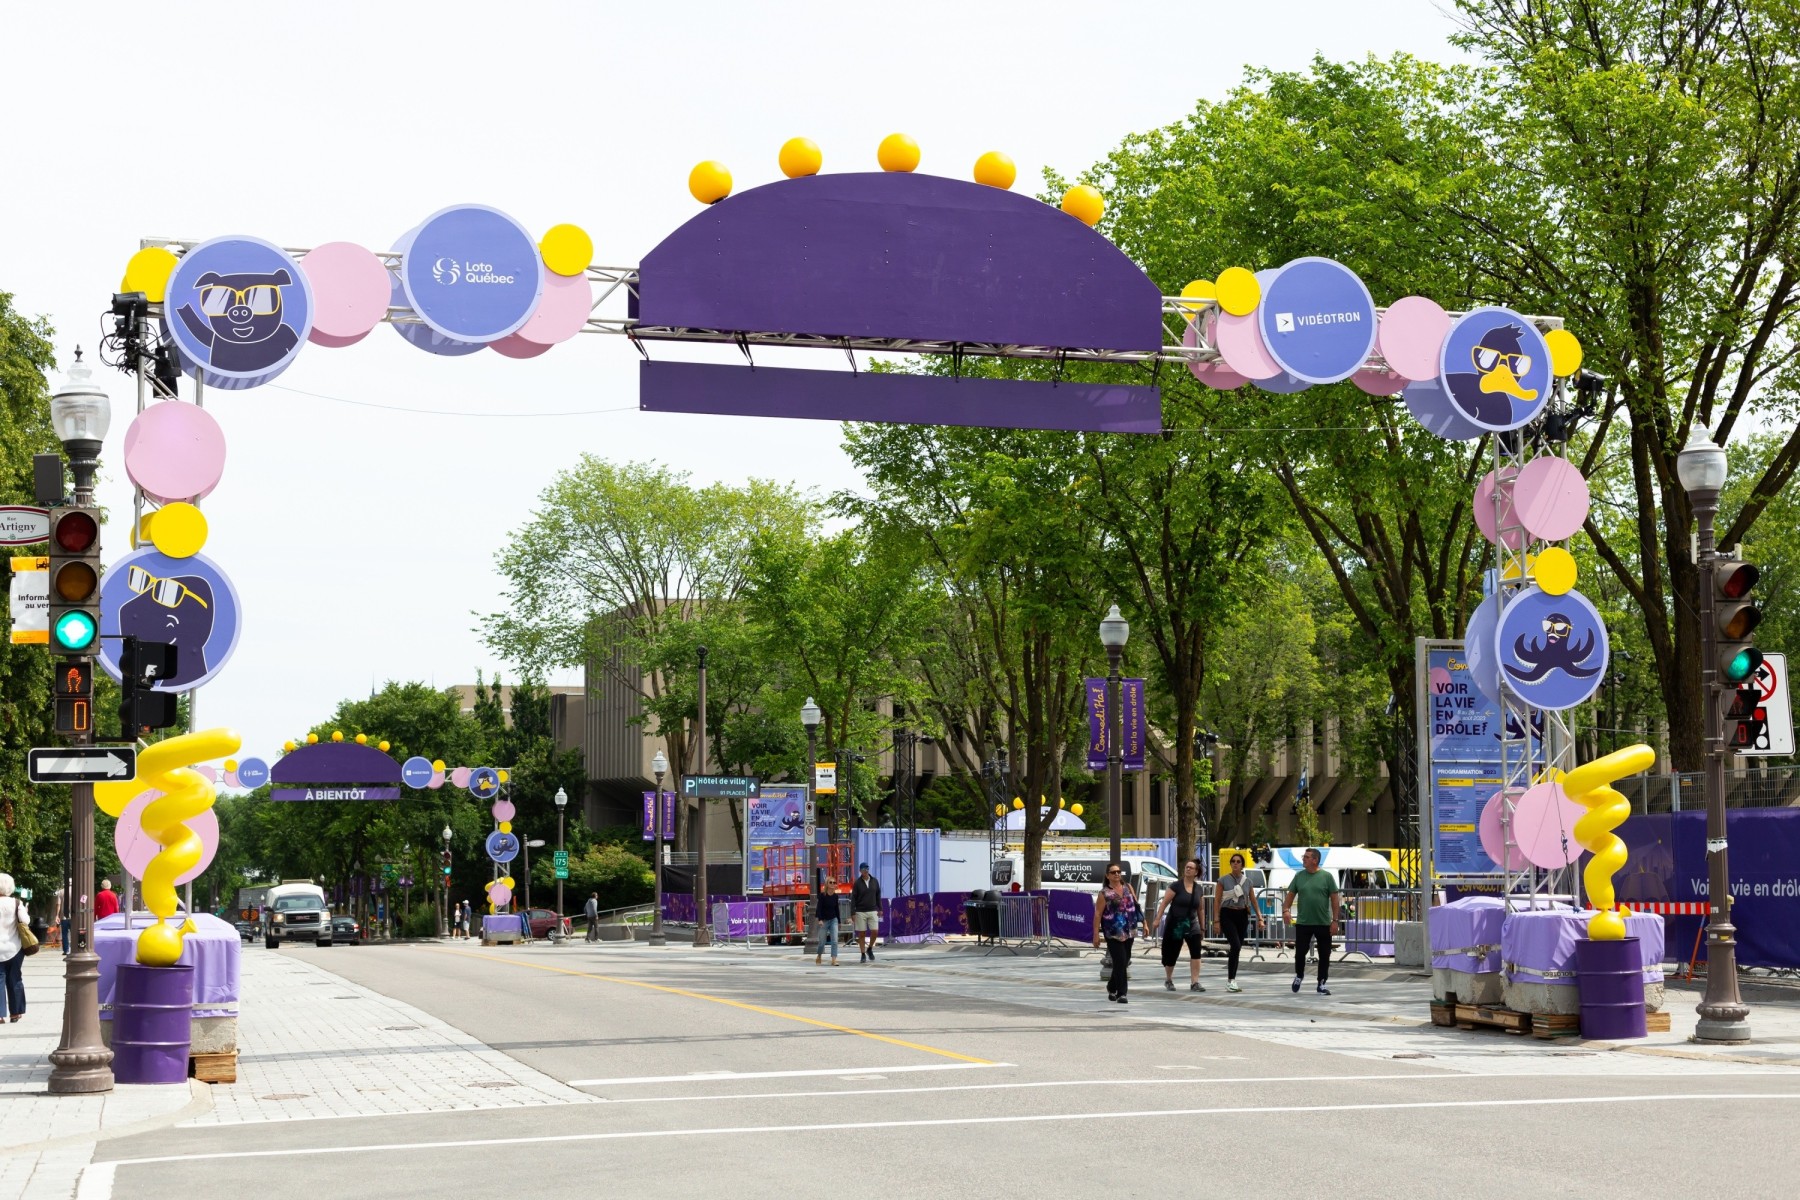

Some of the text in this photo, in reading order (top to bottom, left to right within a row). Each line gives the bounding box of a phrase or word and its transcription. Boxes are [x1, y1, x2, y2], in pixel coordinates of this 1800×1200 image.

[466, 262, 493, 272] Loto
[466, 272, 514, 284] Québec
[1297, 312, 1361, 326] VIDÉOTRON
[1436, 683, 1468, 695] VOIR
[1436, 697, 1475, 708] LA VIE
[1131, 707, 1137, 717] en
[1436, 711, 1453, 721] EN
[1436, 721, 1488, 736] DRÔLE!
[1131, 731, 1138, 739] la
[685, 777, 746, 793] P Hôtel de ville
[305, 788, 367, 800] À BIENTÔT
[555, 858, 567, 866] 175
[1690, 878, 1710, 896] Voi
[1731, 878, 1751, 896] vie
[1754, 883, 1769, 896] en
